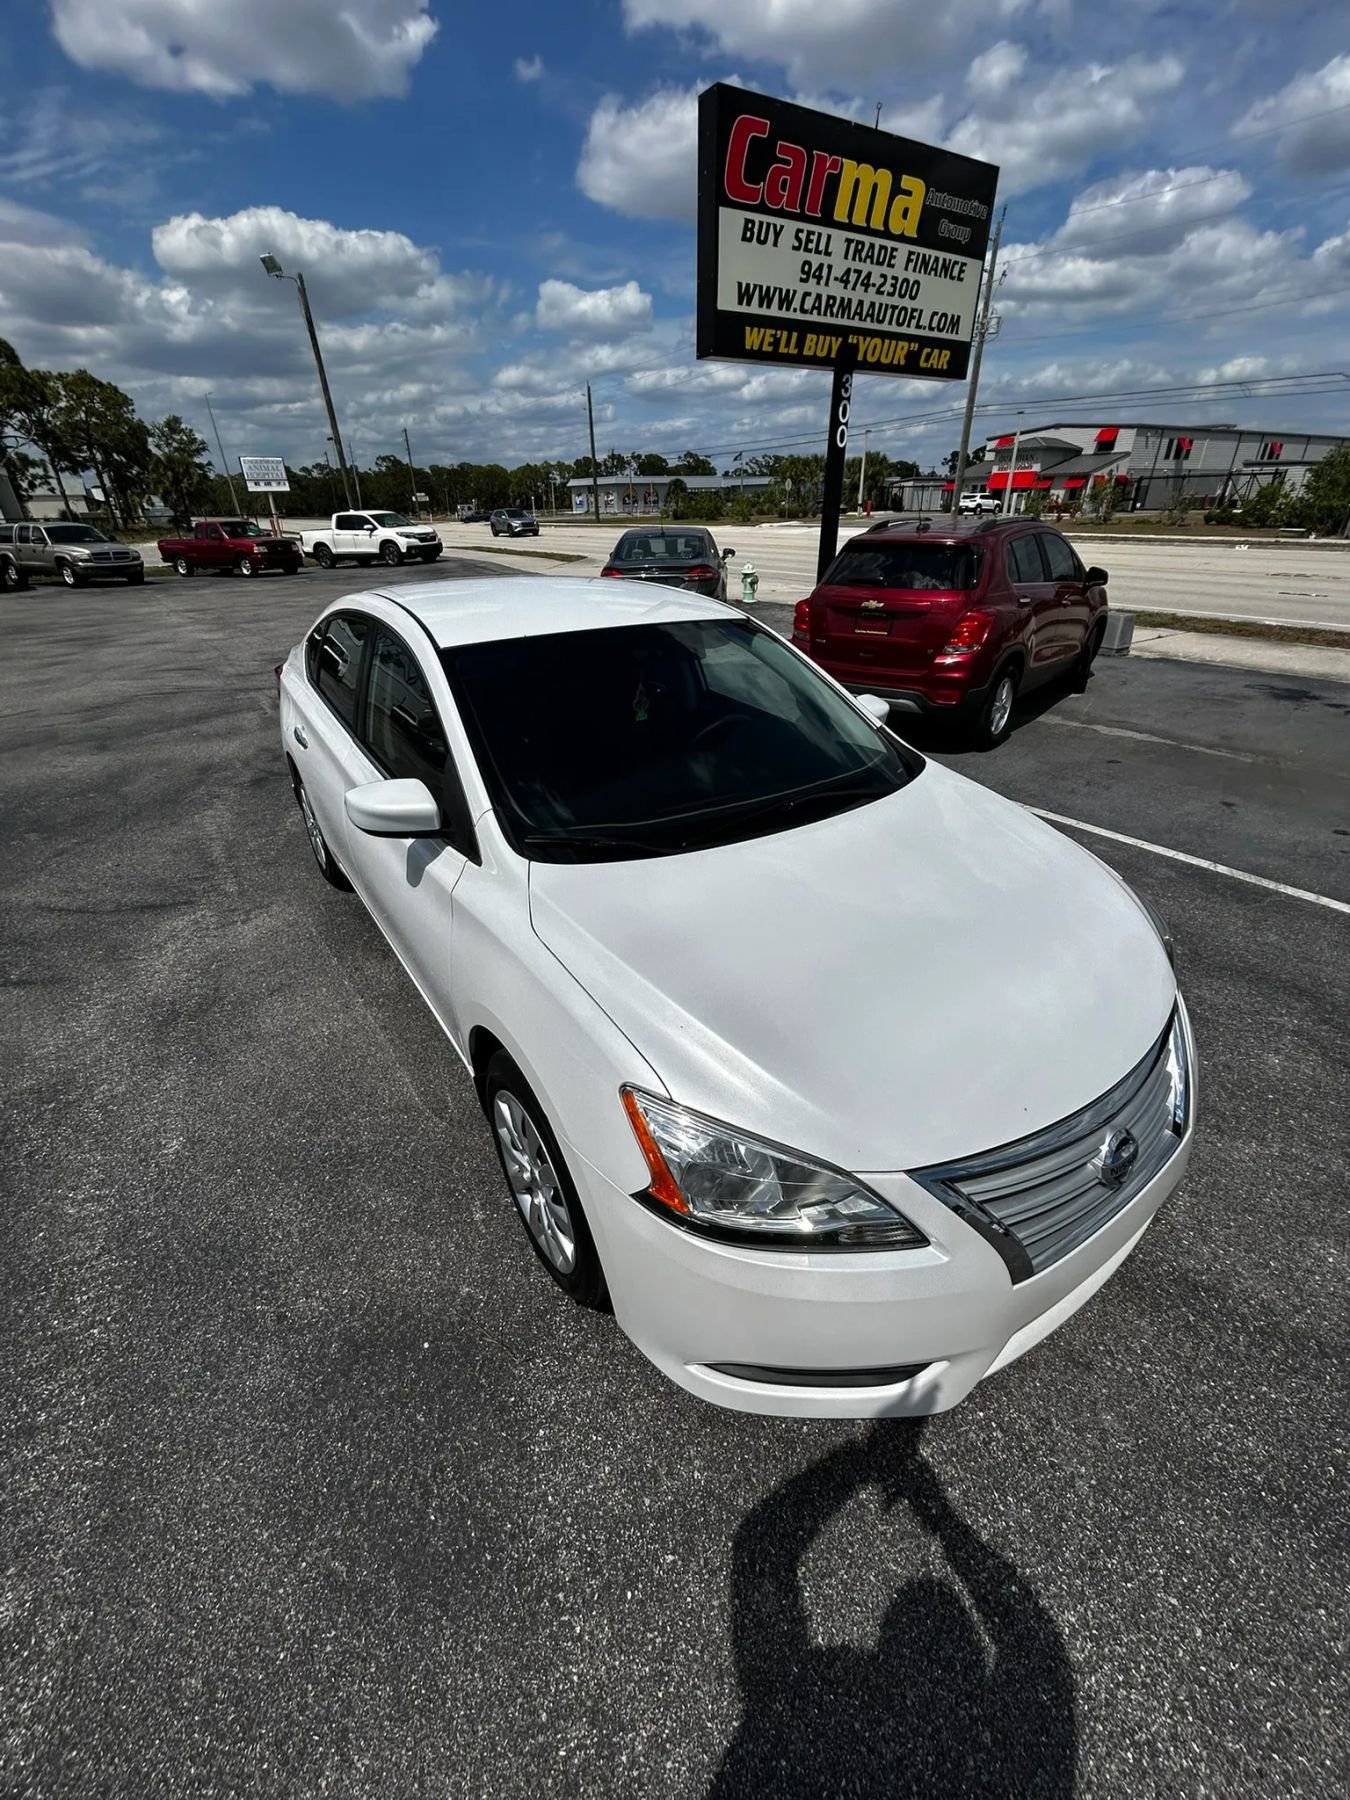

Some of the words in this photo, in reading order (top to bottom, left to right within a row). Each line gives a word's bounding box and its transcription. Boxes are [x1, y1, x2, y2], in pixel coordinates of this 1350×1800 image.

[724, 114, 926, 238] Carma
[925, 188, 988, 219] Automotive
[741, 217, 784, 248] BUY
[791, 227, 833, 258] SELL
[843, 237, 898, 268] TRADE
[904, 249, 967, 282] FINANCE
[938, 218, 971, 244] Group
[799, 259, 921, 301] 941-474-2300
[736, 281, 962, 335] WWW.CARMAAUTOFL.COM
[744, 326, 799, 355] WE'LL
[803, 335, 842, 358] BUY
[848, 334, 919, 365] "YOUR"
[919, 347, 951, 370] CAR
[836, 373, 852, 448] 300
[248, 464, 282, 472] ANIMAL
